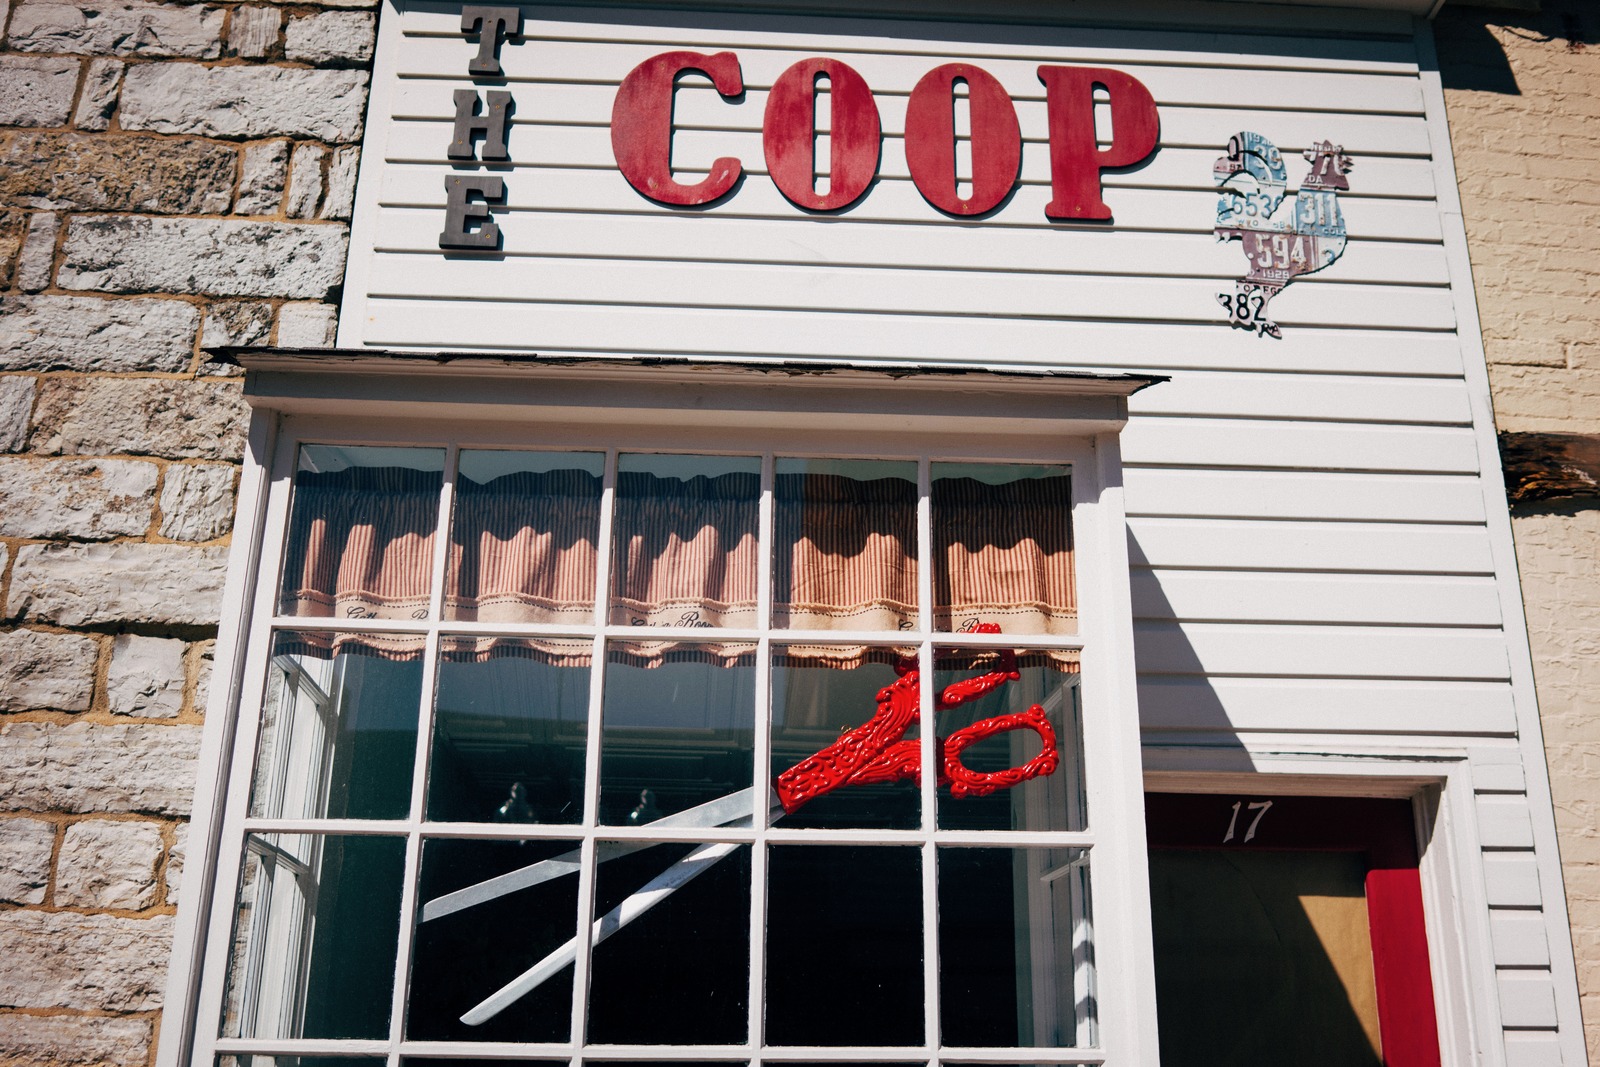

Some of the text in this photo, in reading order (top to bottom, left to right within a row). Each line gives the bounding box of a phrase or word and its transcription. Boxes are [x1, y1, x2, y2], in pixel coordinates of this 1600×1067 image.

[439, 5, 520, 251] THE
[611, 50, 1160, 221] COOP
[1299, 192, 1340, 227] 311
[1256, 232, 1307, 270] 594
[1218, 293, 1266, 322] 382
[1222, 800, 1274, 844] 17
